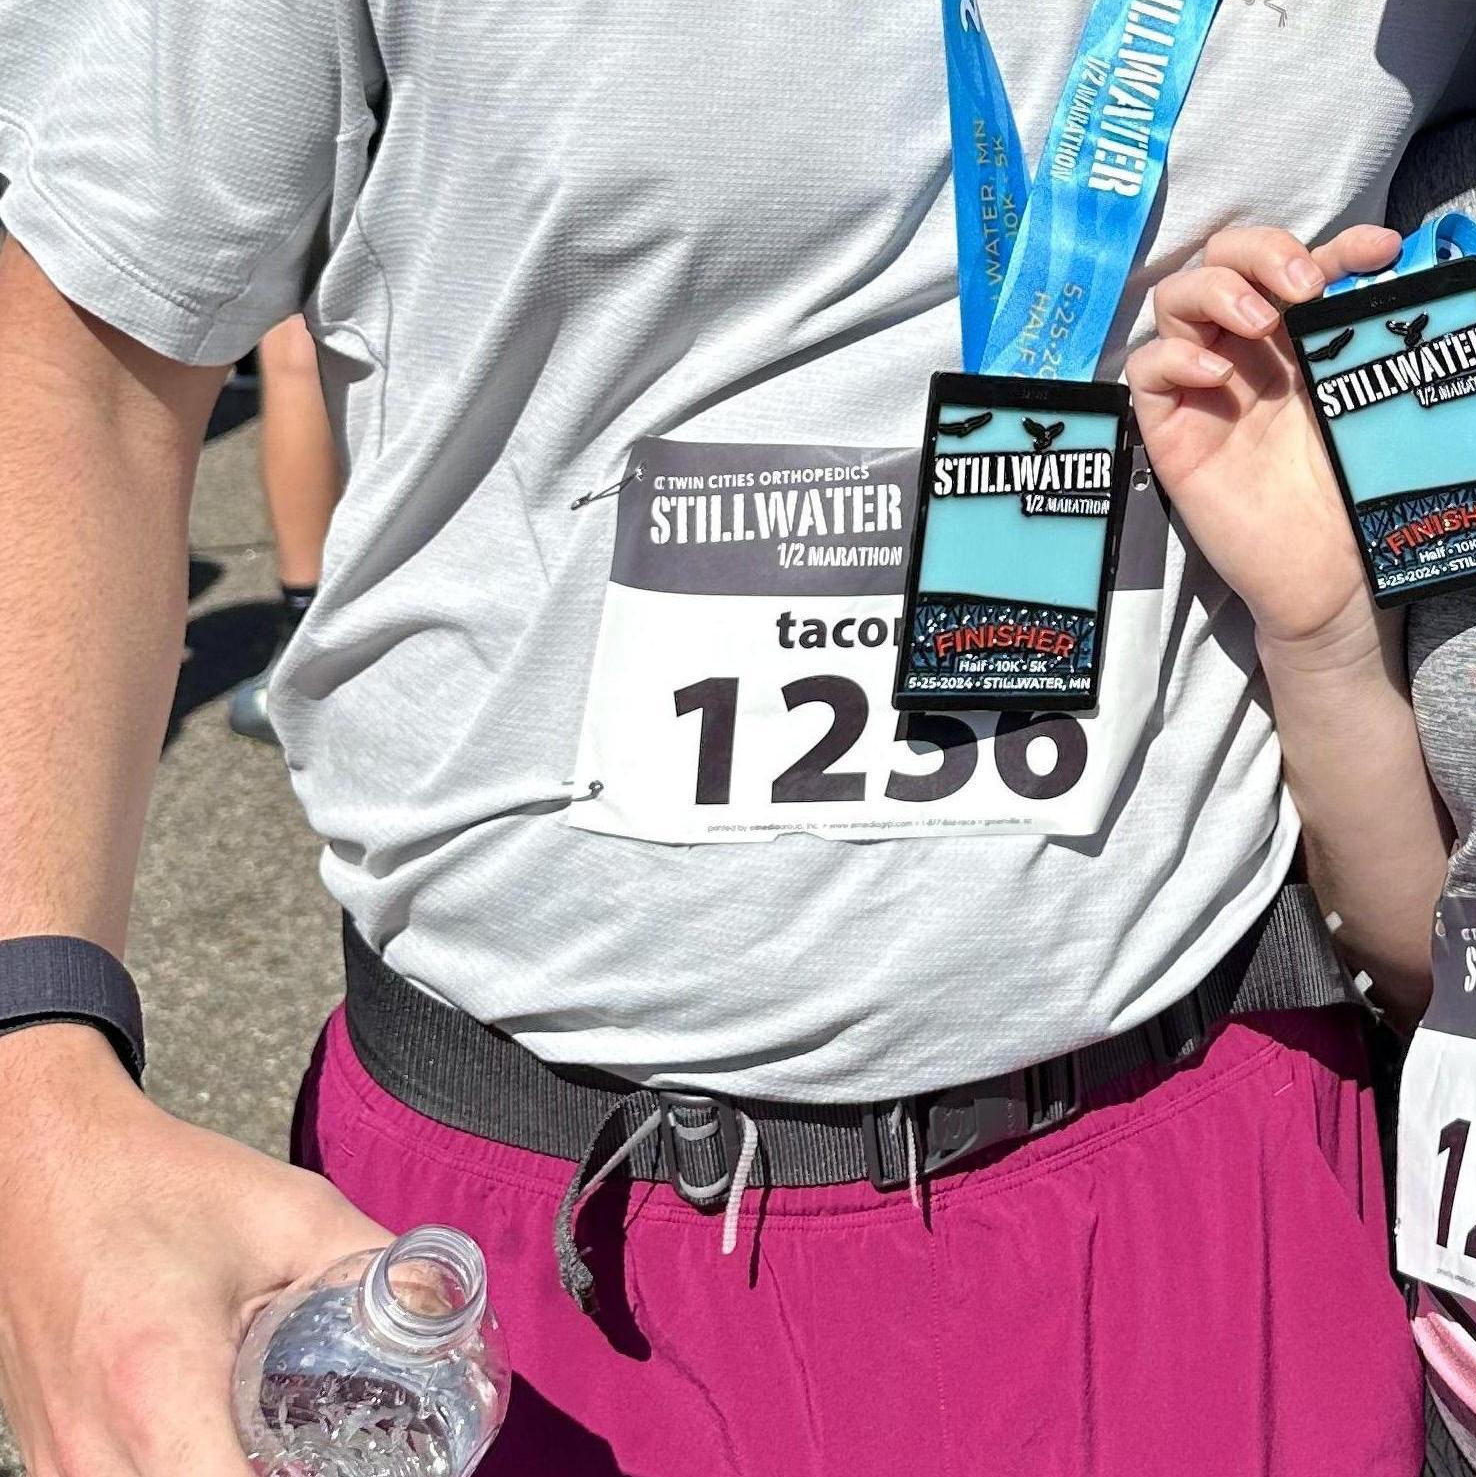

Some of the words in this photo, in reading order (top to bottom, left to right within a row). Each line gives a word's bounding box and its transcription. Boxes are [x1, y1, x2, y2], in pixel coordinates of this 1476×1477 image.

[1081, 55, 1112, 84] 1/2
[976, 119, 992, 165] MN
[1051, 83, 1096, 183] MARATHON
[1018, 290, 1050, 365] HALF
[1416, 387, 1438, 407] 1/2
[667, 475, 704, 490] TWIN
[708, 472, 755, 489] CITIES
[759, 465, 870, 486] ORTHOPEDICS
[932, 452, 1112, 497] STILLWATER
[650, 483, 903, 545] STILLWATER
[1025, 494, 1044, 514] 1/2
[1045, 495, 1110, 516] MARATHON
[776, 542, 805, 569] 1/2
[807, 545, 903, 568] MARATHON
[1419, 548, 1446, 565] Half
[933, 624, 1077, 659] FINISHER
[959, 659, 988, 673] Half
[995, 659, 1020, 673] 10K
[1029, 660, 1048, 673] 5K
[983, 676, 1067, 692] STILLWATER,
[1068, 677, 1091, 690] MN
[673, 674, 1088, 806] 1256
